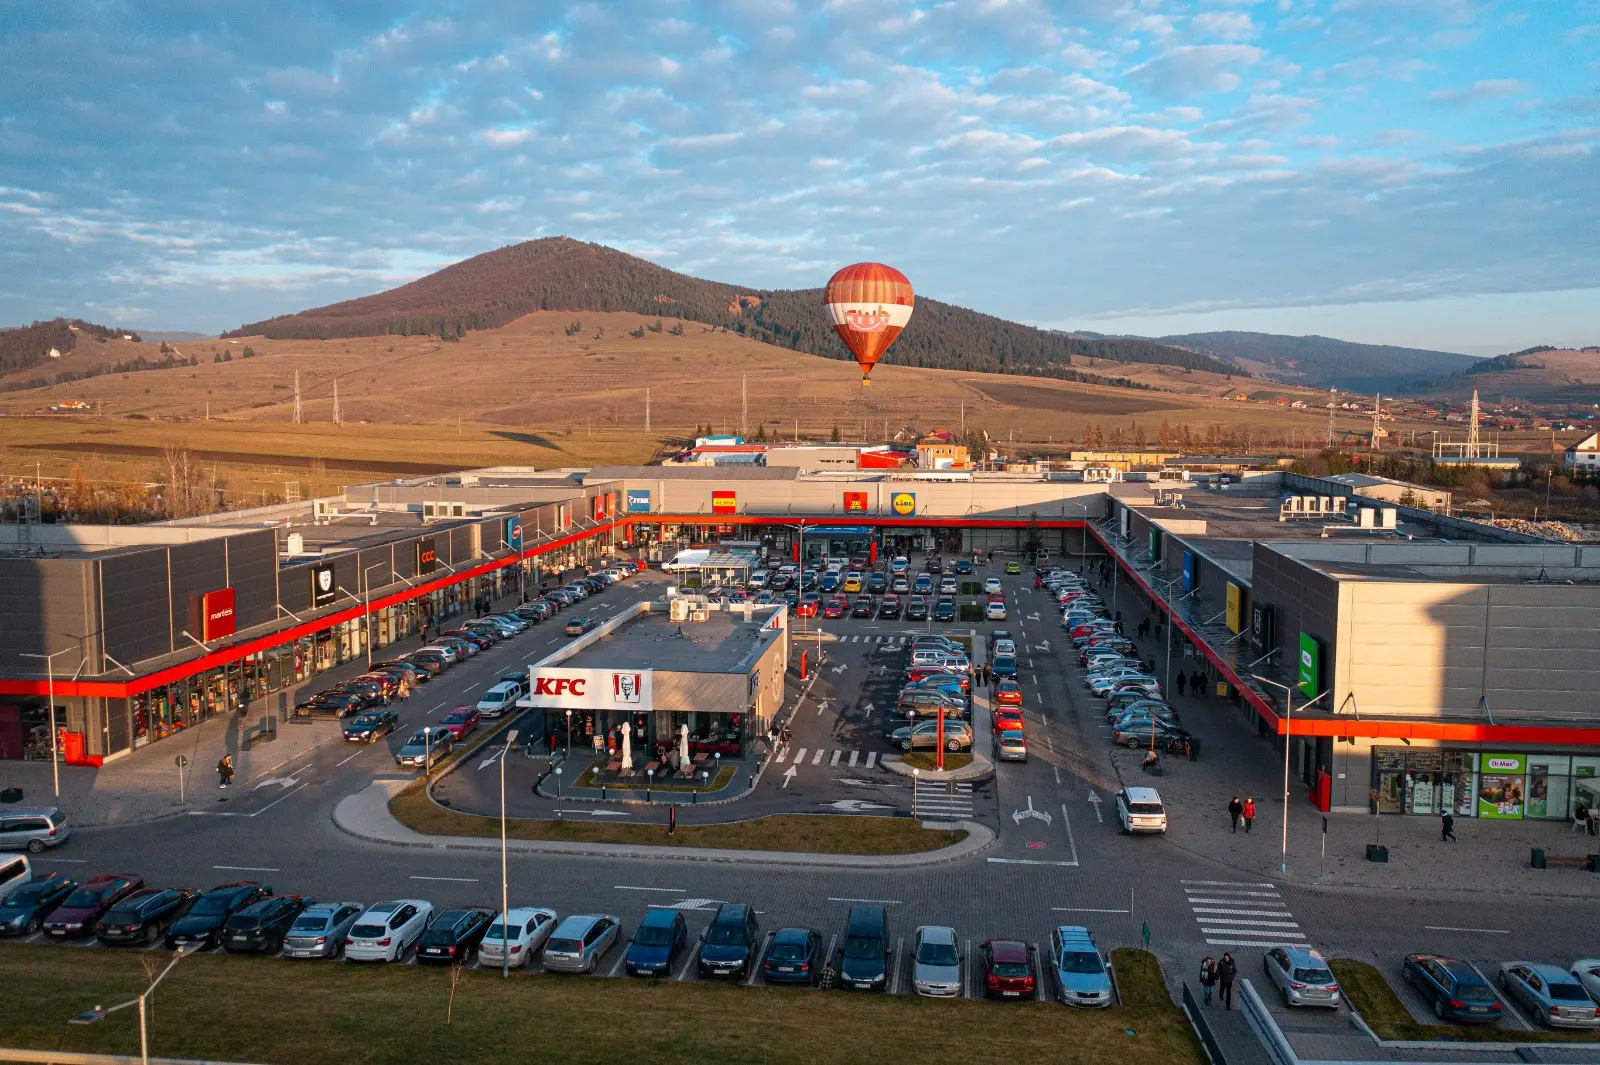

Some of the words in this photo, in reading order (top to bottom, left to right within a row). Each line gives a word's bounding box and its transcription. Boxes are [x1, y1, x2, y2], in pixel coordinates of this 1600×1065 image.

[421, 549, 435, 563] CCC
[210, 608, 233, 621] martes
[533, 677, 586, 697] KFC
